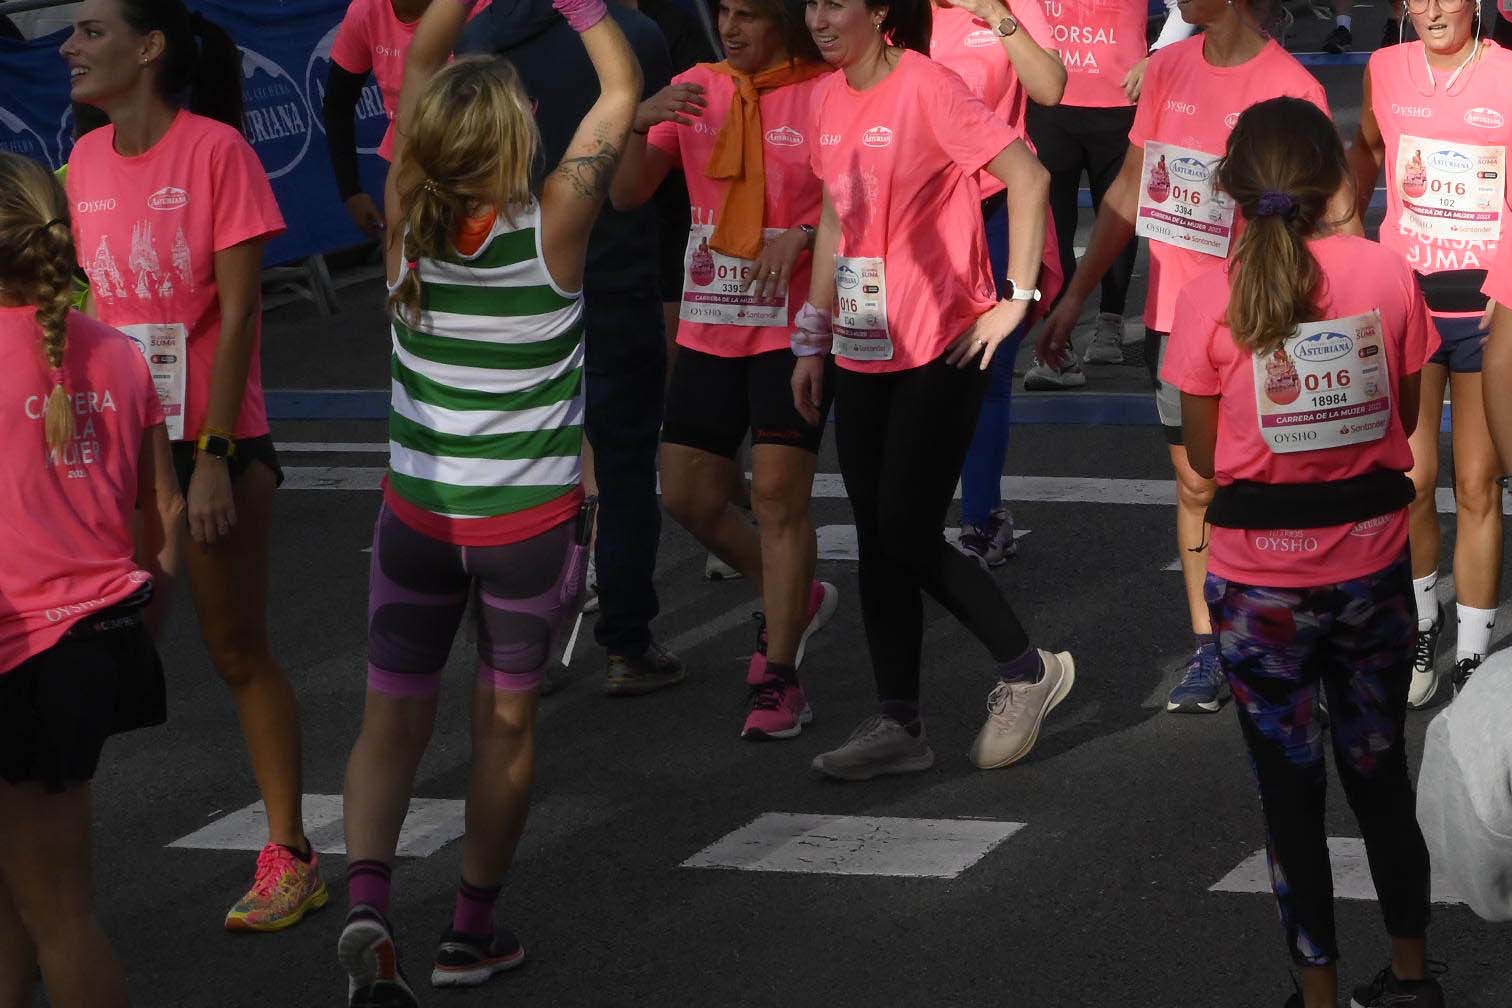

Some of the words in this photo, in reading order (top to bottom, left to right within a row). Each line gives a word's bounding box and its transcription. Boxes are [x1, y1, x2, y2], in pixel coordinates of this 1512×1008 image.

[1044, 0, 1062, 18] TU
[1392, 103, 1432, 119] OYSHO
[1171, 161, 1210, 180] ASTURIANA
[1431, 157, 1470, 171] ASTURIANA
[1172, 185, 1201, 205] 016
[1431, 179, 1466, 196] 016
[77, 198, 117, 213] OYSHO
[1439, 198, 1455, 208] 102
[1434, 209, 1442, 217] DE
[1443, 210, 1451, 218] LA
[1146, 222, 1171, 236] OYSHO
[1172, 216, 1180, 224] DE
[1187, 220, 1206, 232] MUJER
[840, 297, 858, 312] 016
[1299, 342, 1351, 358] ASTURIANA
[1304, 369, 1352, 391] 016
[1312, 393, 1347, 407] 18984
[1276, 412, 1314, 425] CARRERA
[1316, 411, 1328, 420] DE
[1329, 409, 1339, 418] LA
[1341, 406, 1366, 417] MUJER
[1350, 419, 1386, 434] Santander
[1274, 430, 1317, 444] OYSHO
[1256, 536, 1318, 552] OYSHO
